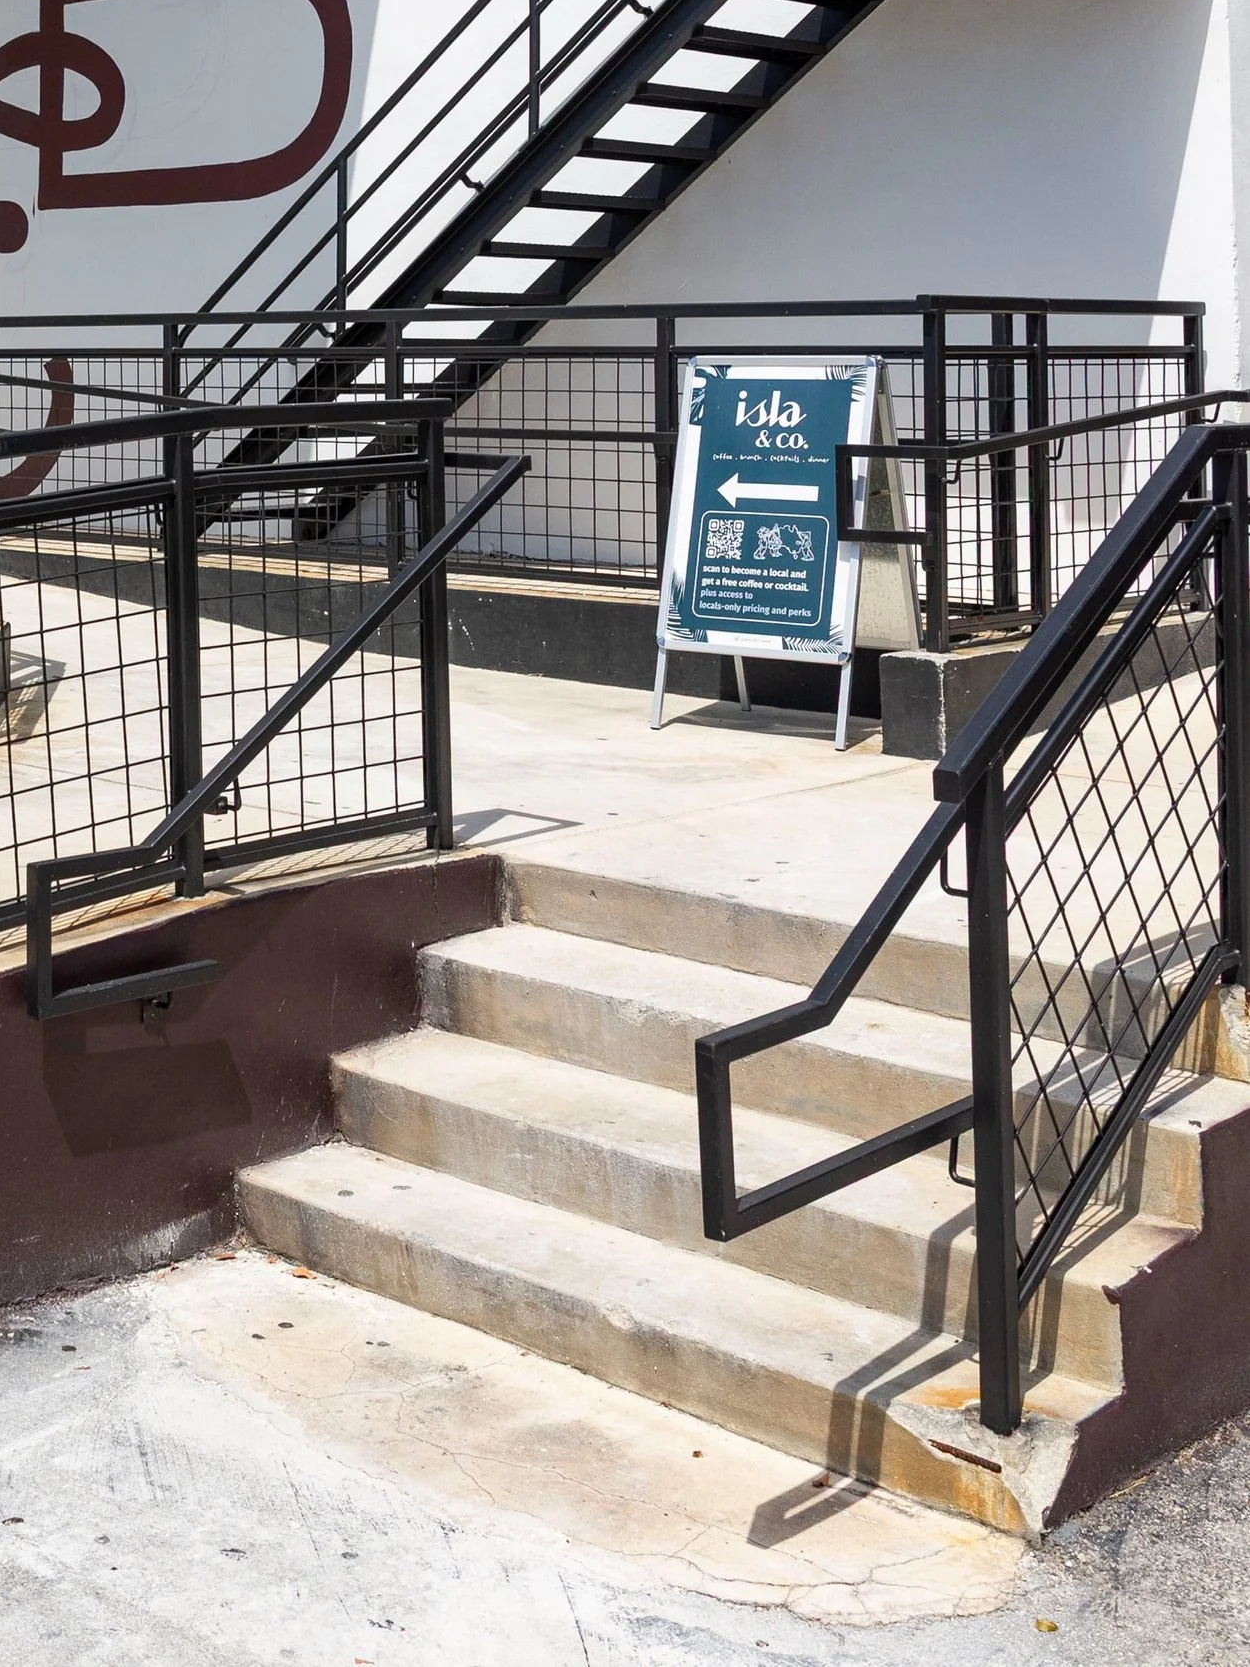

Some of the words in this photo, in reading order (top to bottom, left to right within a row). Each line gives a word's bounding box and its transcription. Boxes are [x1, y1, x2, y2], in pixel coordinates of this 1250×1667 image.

[735, 390, 807, 428] isla
[755, 429, 772, 448] &
[775, 432, 809, 450] co.
[808, 455, 830, 463] dinner
[721, 565, 730, 573] to
[731, 566, 762, 576] become
[769, 568, 789, 577] local
[790, 570, 806, 579] and
[701, 578, 714, 586] get
[721, 578, 737, 587] free
[738, 580, 763, 589] coffee
[700, 588, 717, 597] plus
[718, 590, 744, 599] access
[744, 592, 753, 600] to
[699, 600, 741, 613] locals-only
[742, 603, 770, 615] pricing
[771, 607, 787, 615] and
[788, 608, 812, 617] perks
